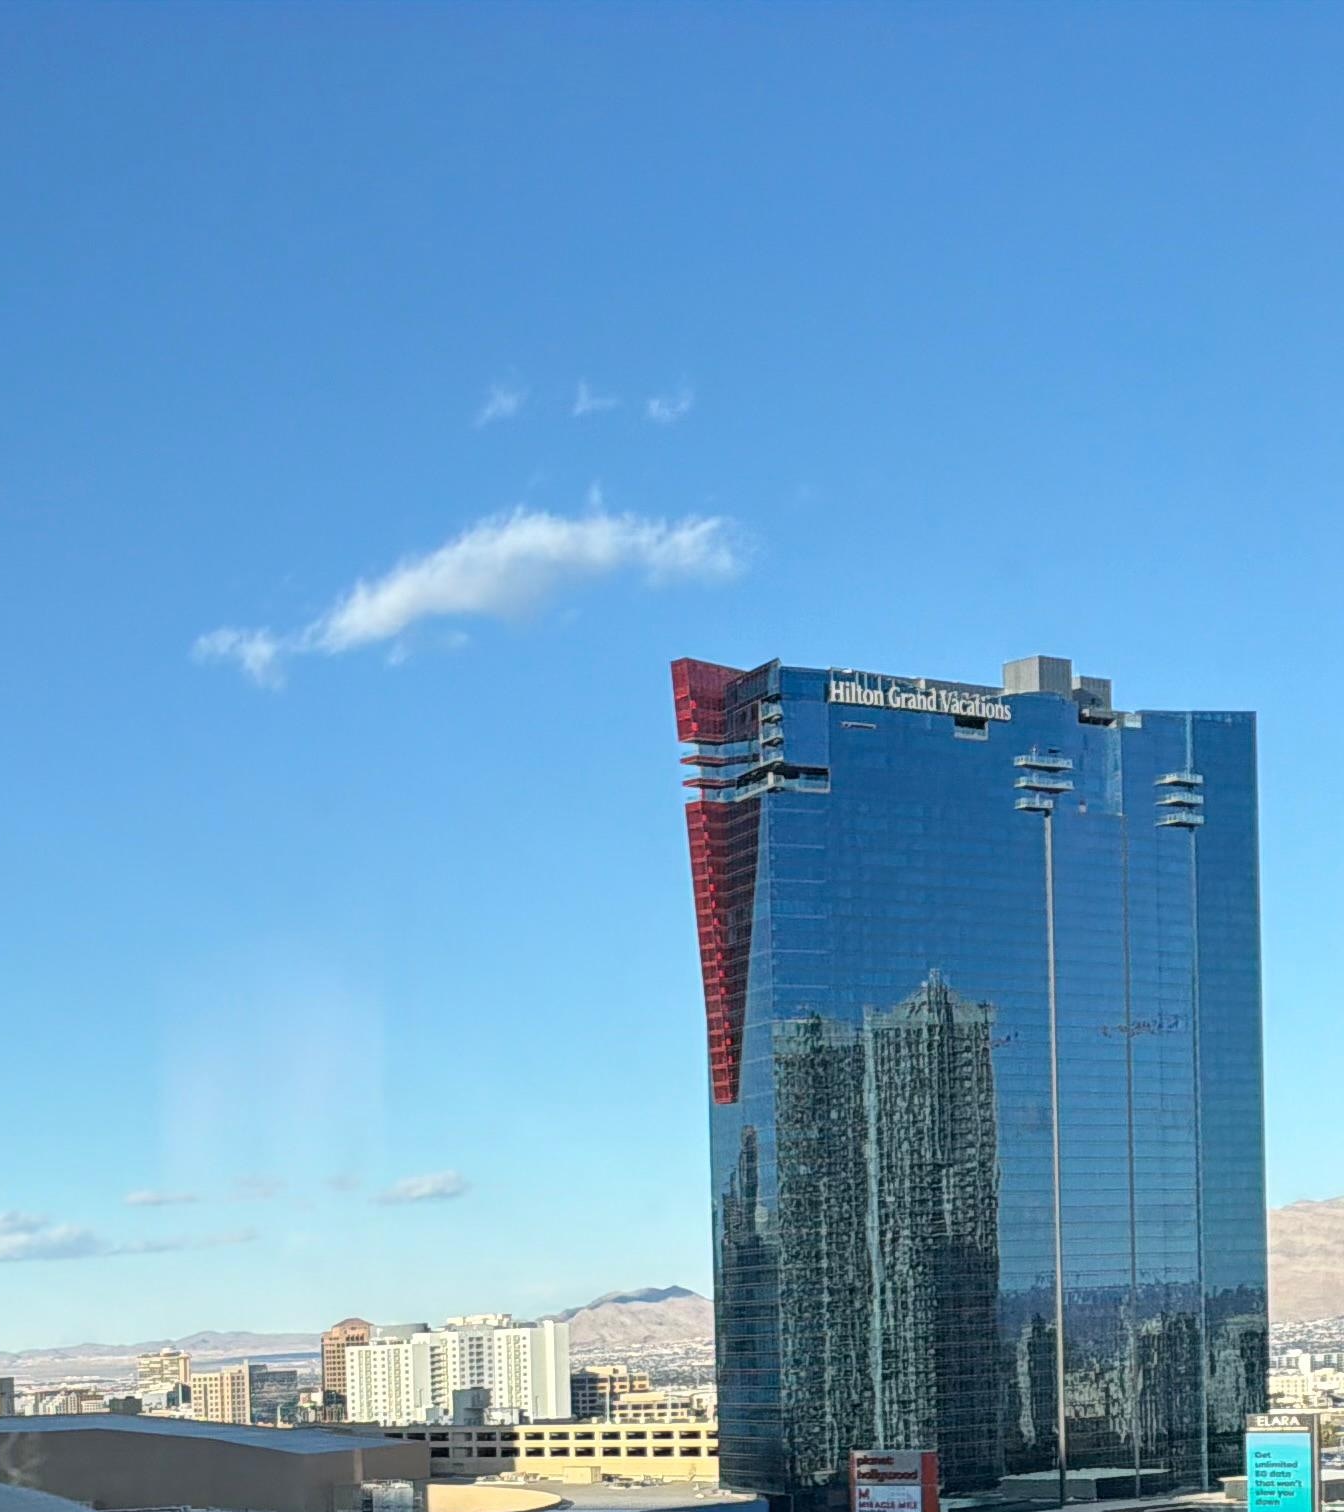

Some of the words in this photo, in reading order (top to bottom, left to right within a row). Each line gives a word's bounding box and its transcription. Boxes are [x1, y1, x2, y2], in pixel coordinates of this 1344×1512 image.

[829, 679, 884, 706] Hilton
[888, 685, 937, 713] Grand
[939, 690, 1012, 722] Vacations
[1256, 1415, 1301, 1427] ELARA
[1254, 1451, 1271, 1459] Get
[1254, 1460, 1298, 1469] unlimited
[1269, 1469, 1292, 1478] data
[1254, 1479, 1275, 1487] that
